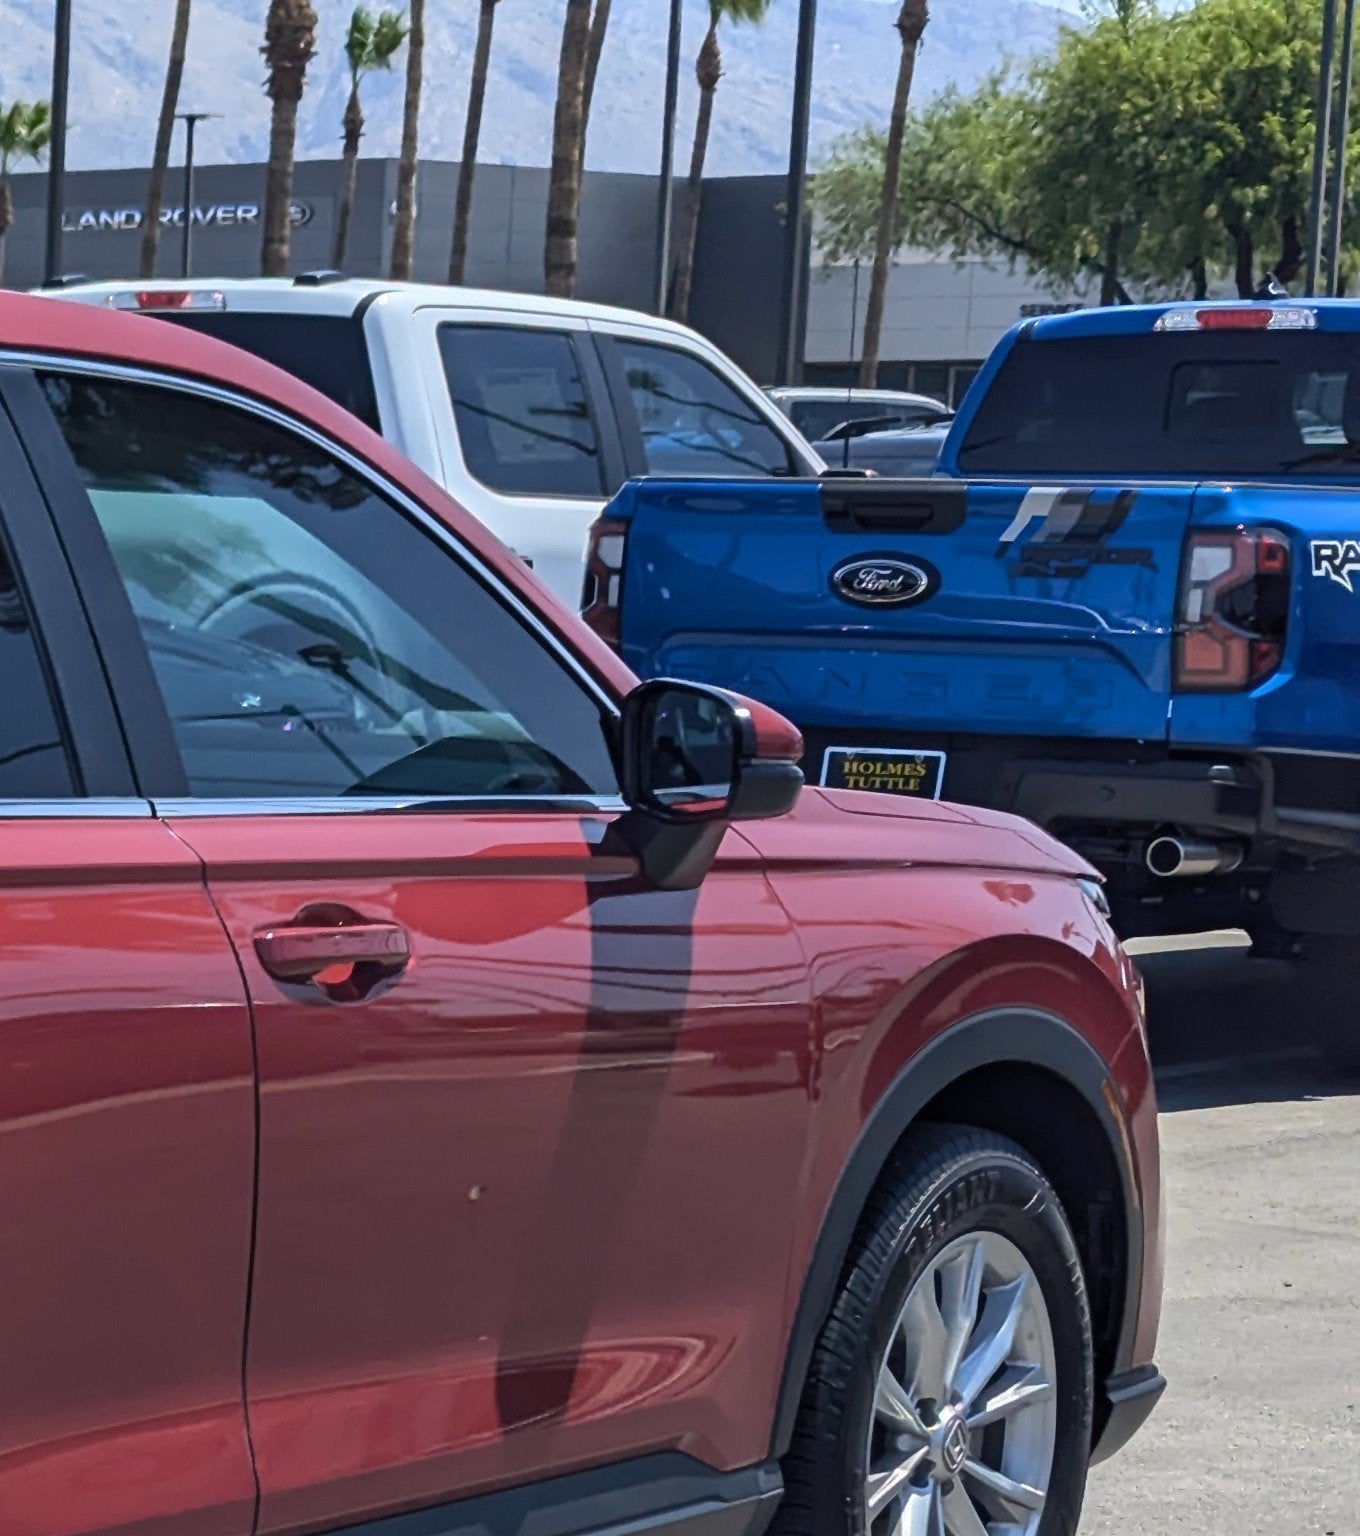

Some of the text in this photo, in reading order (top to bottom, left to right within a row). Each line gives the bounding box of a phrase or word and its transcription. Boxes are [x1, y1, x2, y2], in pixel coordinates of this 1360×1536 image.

[61, 205, 258, 231] LAND ROVER
[854, 567, 905, 592] Ford
[843, 760, 927, 777] HOLMES
[845, 774, 920, 791] TUTTLE
